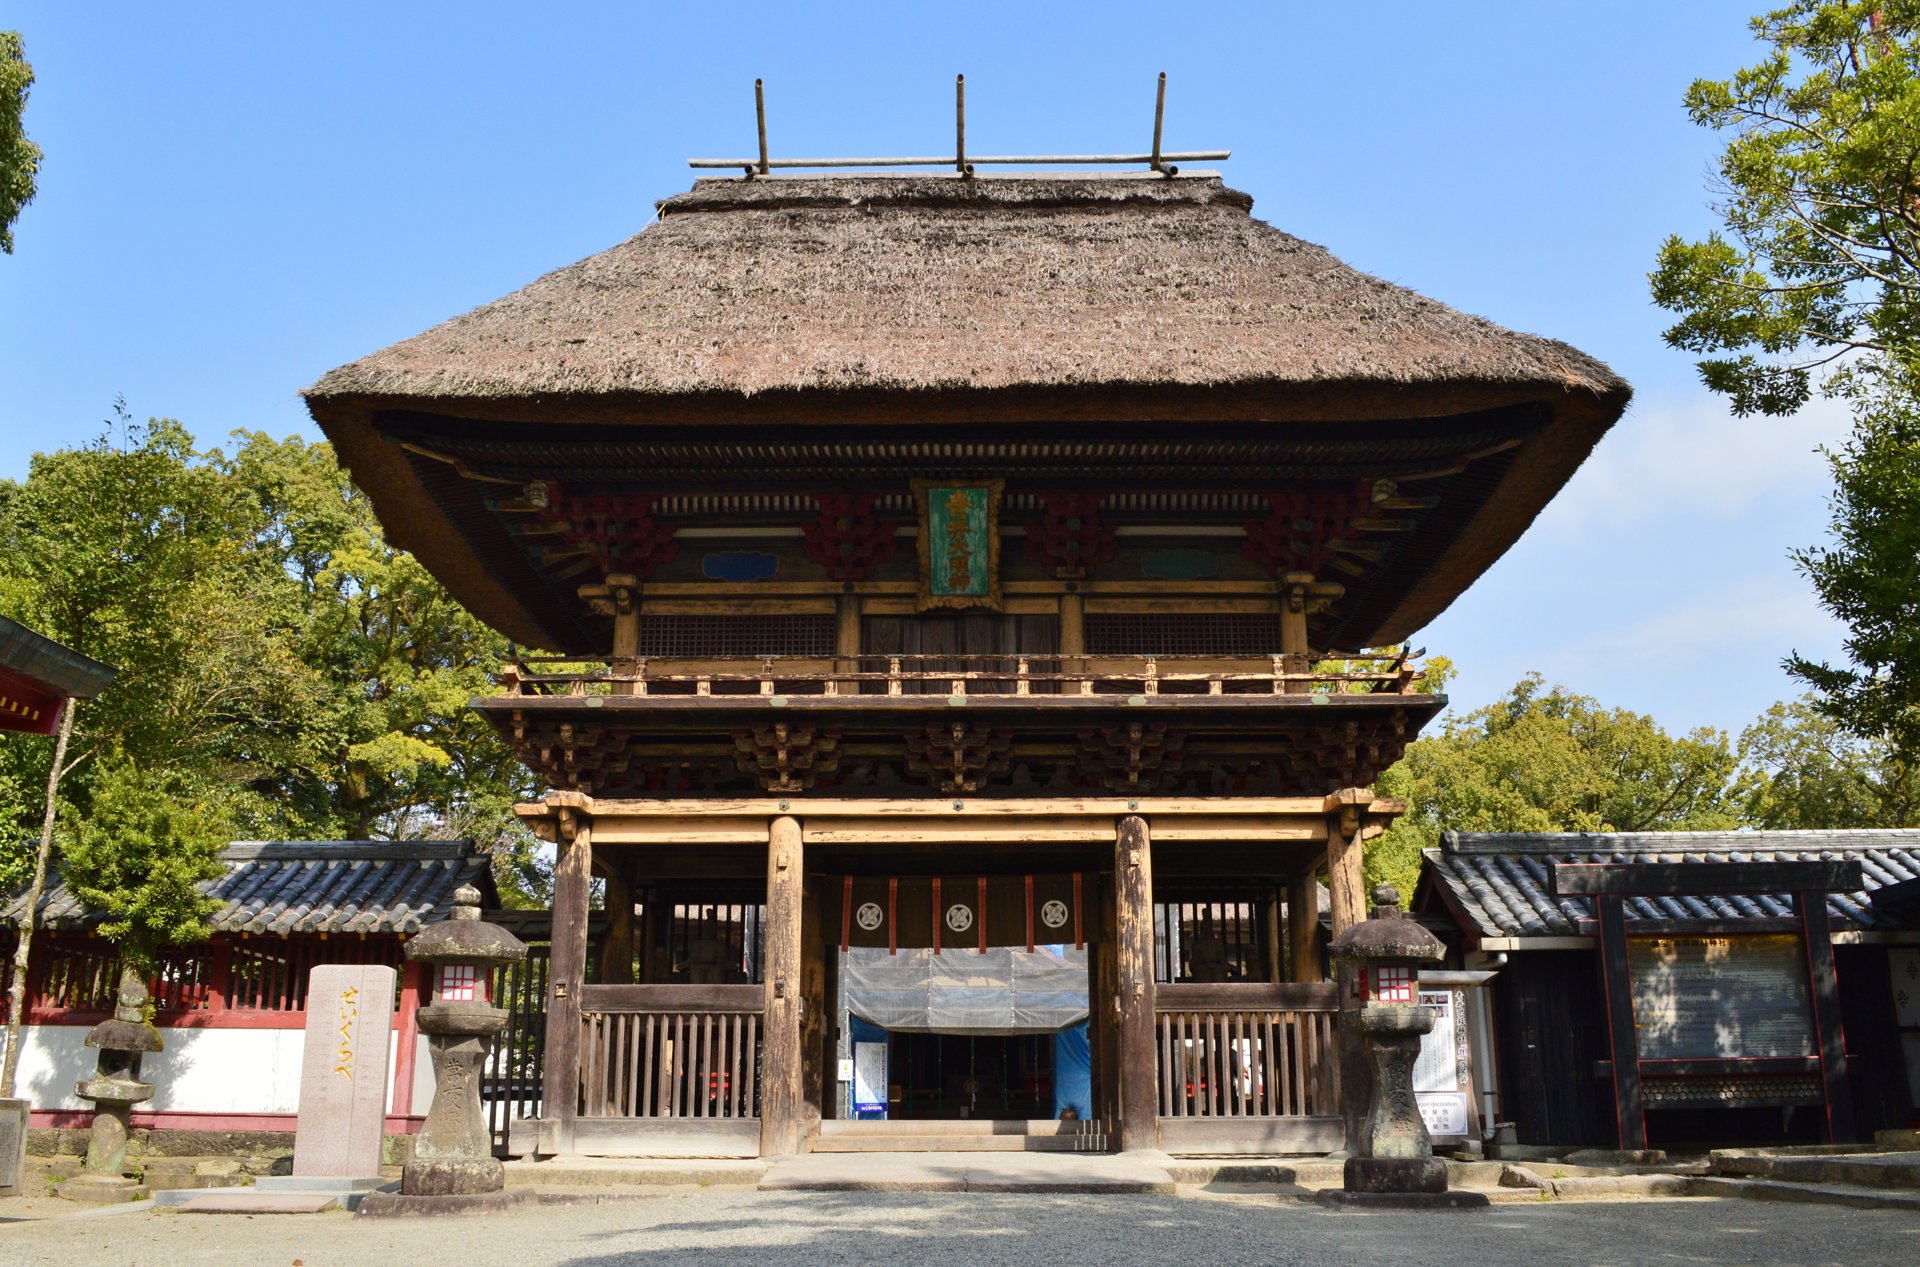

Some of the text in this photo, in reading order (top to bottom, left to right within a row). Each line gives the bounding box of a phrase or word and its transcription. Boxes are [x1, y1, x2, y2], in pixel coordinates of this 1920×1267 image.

[334, 987, 359, 1080] せいくらべ
